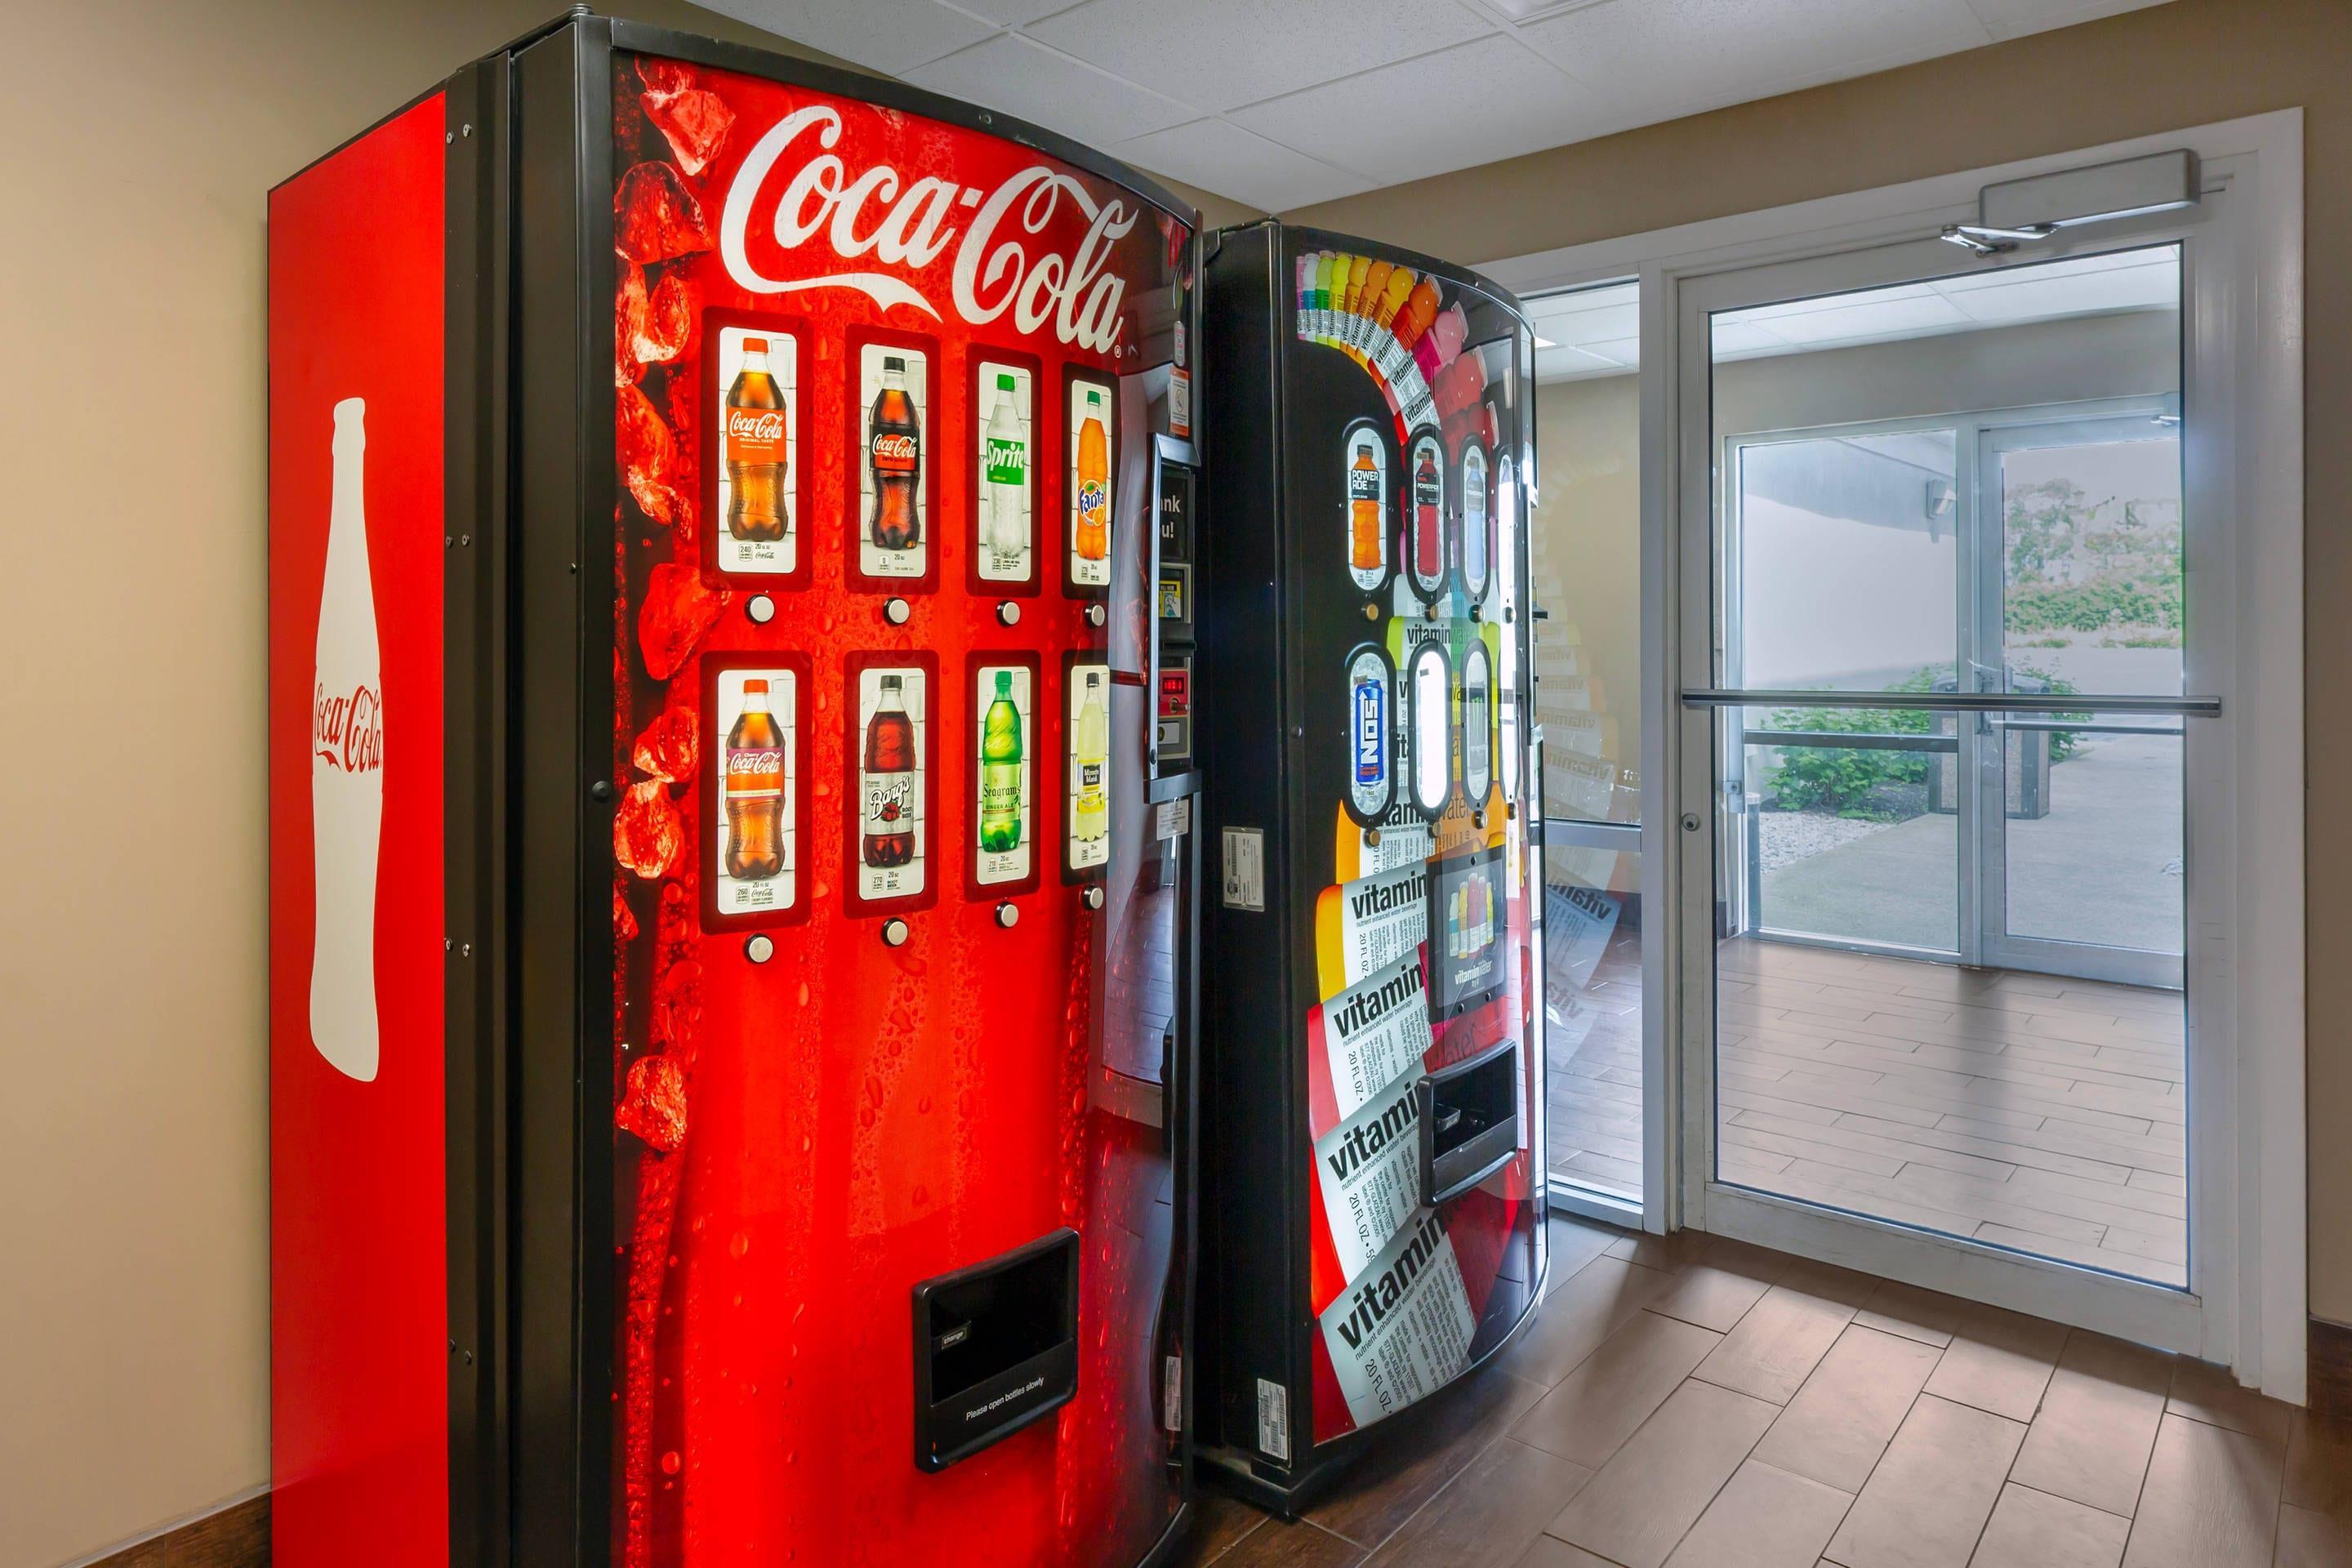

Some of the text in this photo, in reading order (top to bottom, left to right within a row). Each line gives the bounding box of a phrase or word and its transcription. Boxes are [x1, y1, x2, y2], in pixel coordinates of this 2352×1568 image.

[719, 105, 1138, 354] Coca-Cola
[1351, 314, 1363, 345] vitamin
[1361, 319, 1378, 350] vitamin
[1376, 332, 1396, 364] vitamin
[1392, 355, 1415, 385] vitamin
[1405, 391, 1433, 422] vitamin
[730, 411, 783, 439] Coca-Cola
[873, 434, 917, 457] Coca-Cola
[1352, 469, 1379, 481] POWER
[1080, 488, 1105, 515] Fanta
[1160, 495, 1180, 513] nk
[314, 682, 381, 773] Coca-Cola
[1359, 691, 1379, 764] NOS
[730, 752, 782, 775] Coca-Cola
[870, 776, 911, 821] Barq's
[983, 783, 1020, 799] Seagram's
[737, 888, 748, 897] 260
[1352, 871, 1427, 920] vitamin
[1334, 963, 1424, 1038] vitamin
[1361, 1020, 1382, 1039] enhanced
[1342, 1172, 1362, 1192] nutrient
[1362, 1152, 1386, 1174] enhanced
[1385, 1140, 1399, 1158] water
[1348, 1192, 1370, 1241] 20 FL OZ
[1337, 1207, 1447, 1351] vitamin
[1356, 1256, 1437, 1361] nutrient enhanced water beverage
[944, 1331, 964, 1344] change
[966, 1377, 1045, 1421] Please open bottles slowly
[1365, 1358, 1391, 1410] 20 FL OZ
